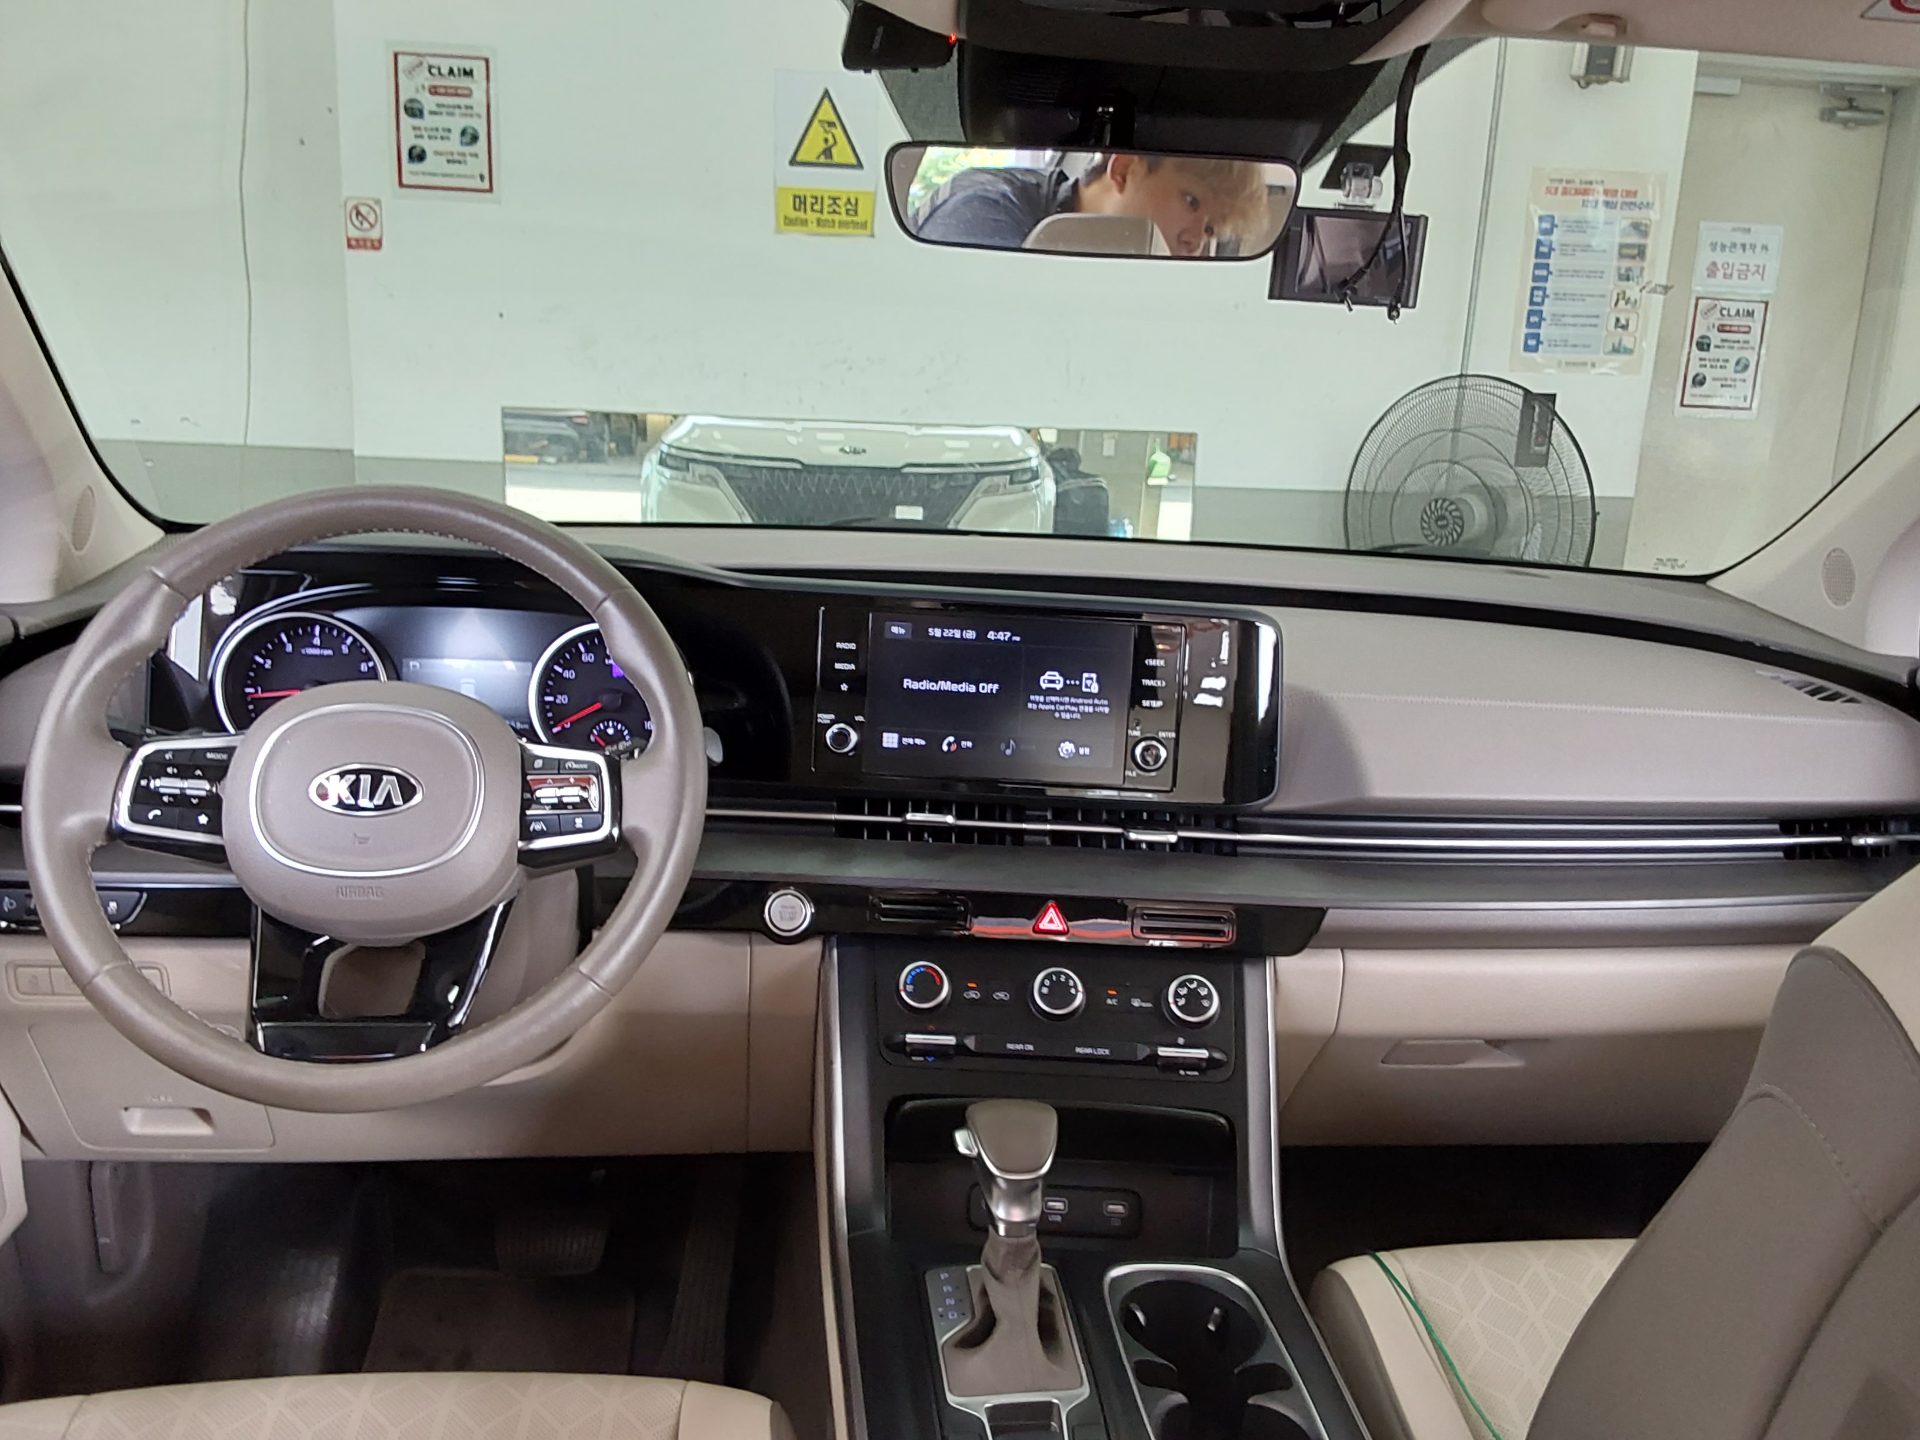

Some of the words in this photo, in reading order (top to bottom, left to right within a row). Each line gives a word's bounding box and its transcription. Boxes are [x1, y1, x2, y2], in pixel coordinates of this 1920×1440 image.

[427, 64, 474, 79] CLAIM
[792, 194, 858, 217] 머리조심
[1706, 260, 1766, 282] 출입금지
[1719, 307, 1755, 318] CLAIM
[943, 628, 961, 638] 22일
[987, 631, 1011, 641] 4:47
[312, 636, 321, 646] 4
[836, 642, 856, 650] RADIO
[285, 643, 293, 653] 3
[341, 644, 349, 654] 5
[581, 653, 595, 663] 60
[264, 659, 272, 669] 2
[360, 662, 368, 673] 6
[834, 662, 856, 670] MEDIA
[562, 669, 576, 679] 40
[903, 678, 976, 693] Radio/Media
[979, 683, 1000, 694] Off
[555, 695, 568, 704] 20
[1070, 697, 1093, 705] Android
[1141, 700, 1163, 708] SETUP
[1038, 703, 1055, 711] Apple
[1055, 704, 1078, 712] CarPlay
[1128, 729, 1141, 737] TUNE
[1158, 731, 1176, 739] ENTER
[328, 774, 404, 808] KIA
[336, 885, 385, 899] AIRBAG
[1060, 974, 1066, 982] 2
[1006, 1043, 1024, 1051] REAR
[1075, 1046, 1093, 1054] REAR
[1092, 1047, 1110, 1055] LOCK
